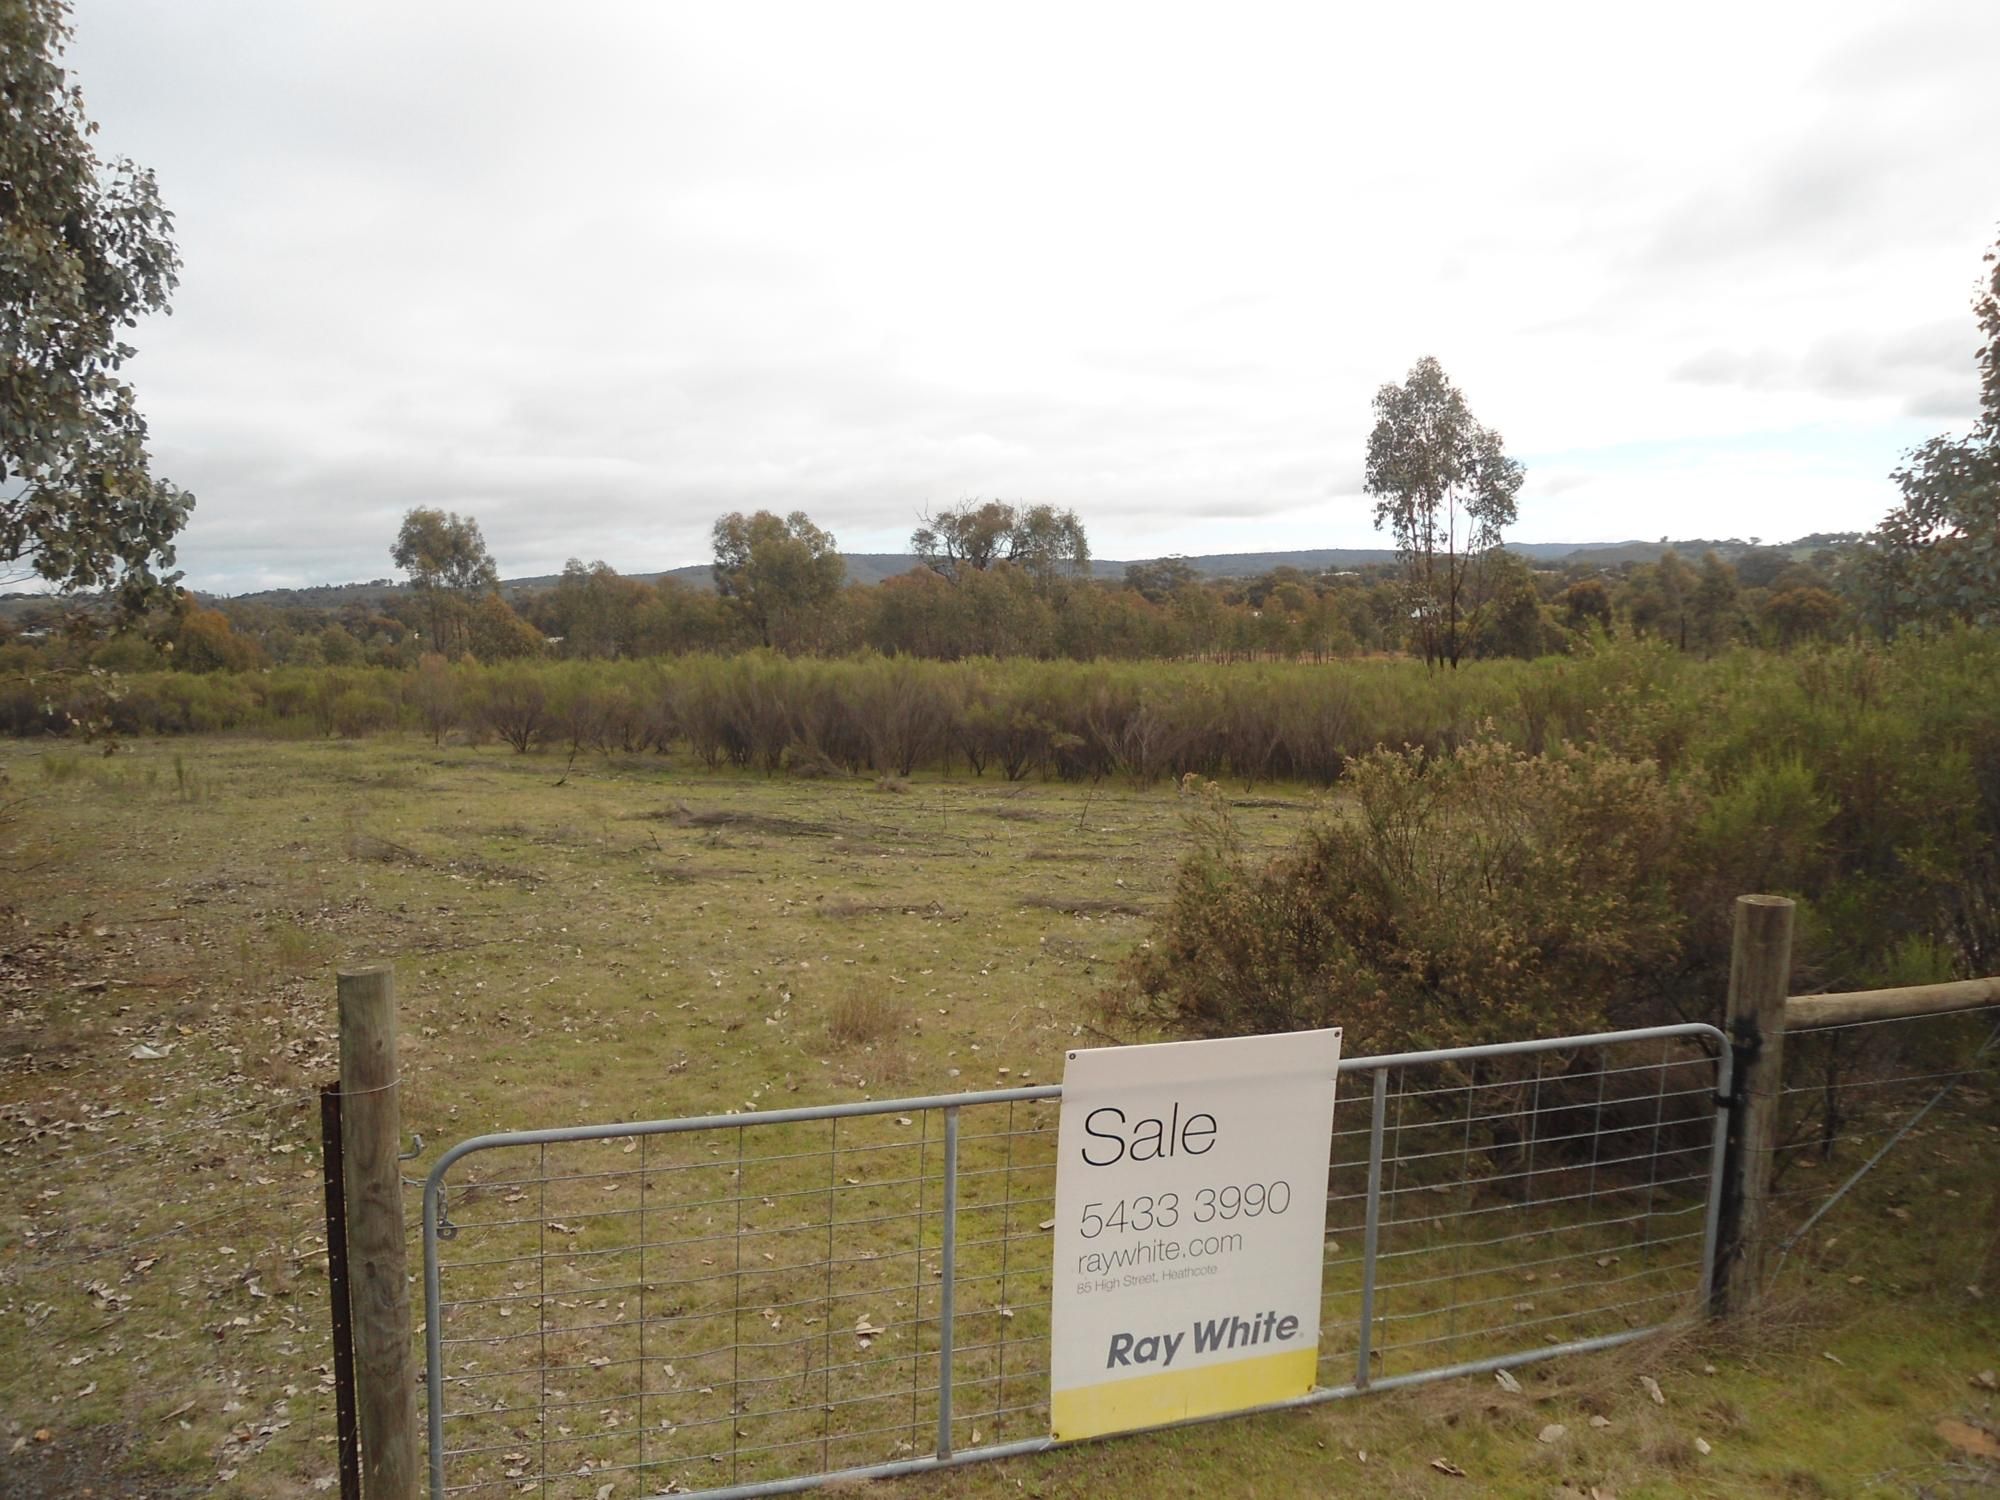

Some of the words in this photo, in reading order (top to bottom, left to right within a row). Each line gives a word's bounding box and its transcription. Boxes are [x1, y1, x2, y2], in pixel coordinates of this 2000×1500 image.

[1081, 1101, 1217, 1167] Sale
[1080, 1192, 1180, 1239] 5433
[1193, 1180, 1291, 1223] 3990
[1078, 1233, 1243, 1276] raywhite.com
[1095, 1278, 1121, 1292] High
[1122, 1273, 1159, 1288] Street,
[1162, 1264, 1219, 1281] Heathcote
[1106, 1332, 1186, 1369] Ray
[1193, 1310, 1300, 1354] White
